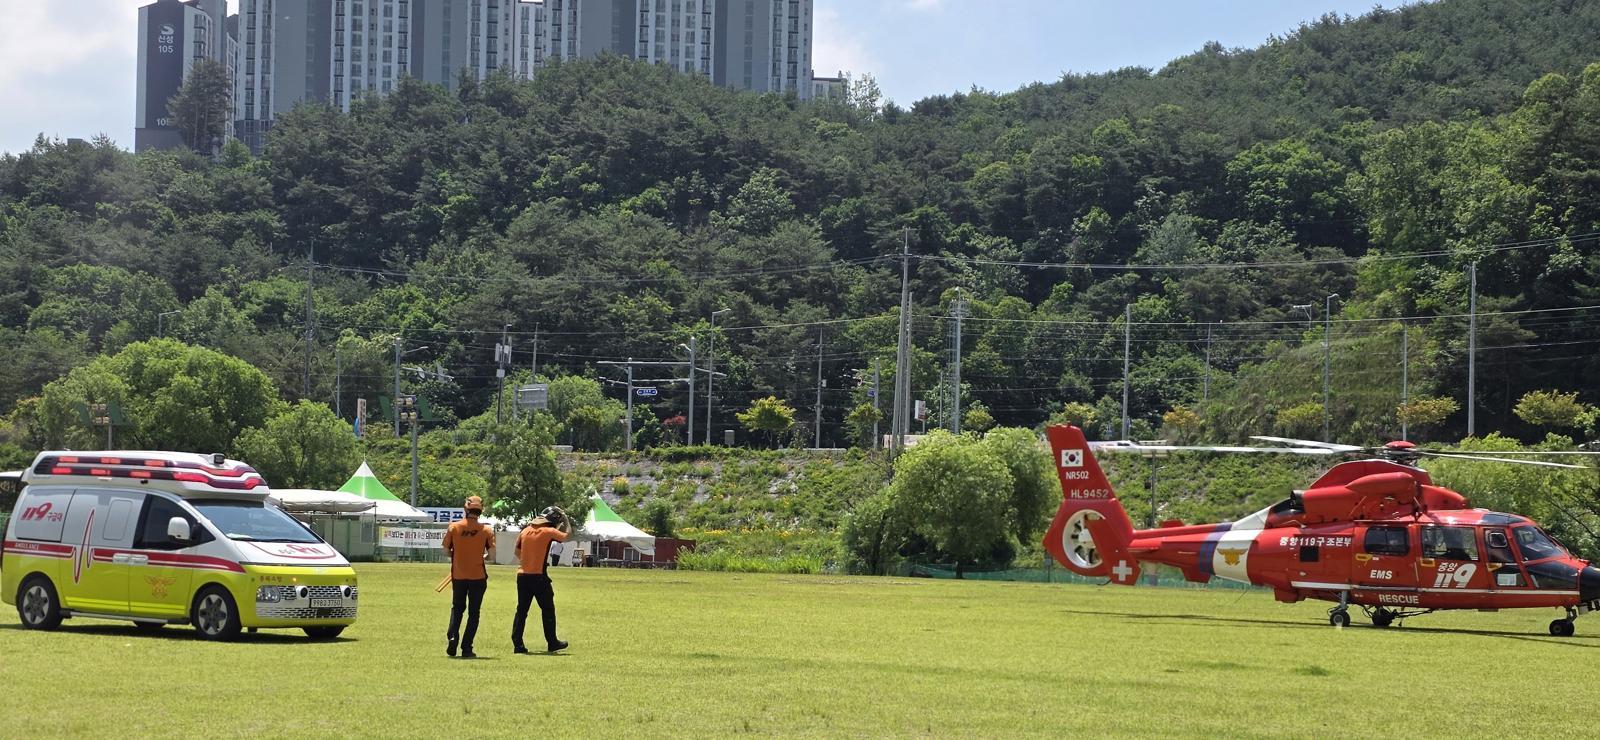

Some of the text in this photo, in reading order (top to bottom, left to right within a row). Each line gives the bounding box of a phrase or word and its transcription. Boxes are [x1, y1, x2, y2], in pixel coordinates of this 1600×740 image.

[158, 45, 174, 53] 105
[1065, 471, 1090, 480] NR502
[1070, 489, 1109, 499] HL9452
[21, 502, 52, 521] 119
[1438, 562, 1458, 572] 중앙
[1370, 569, 1393, 580] EMS
[1433, 563, 1477, 588] 119
[1378, 594, 1420, 604] RESCUE
